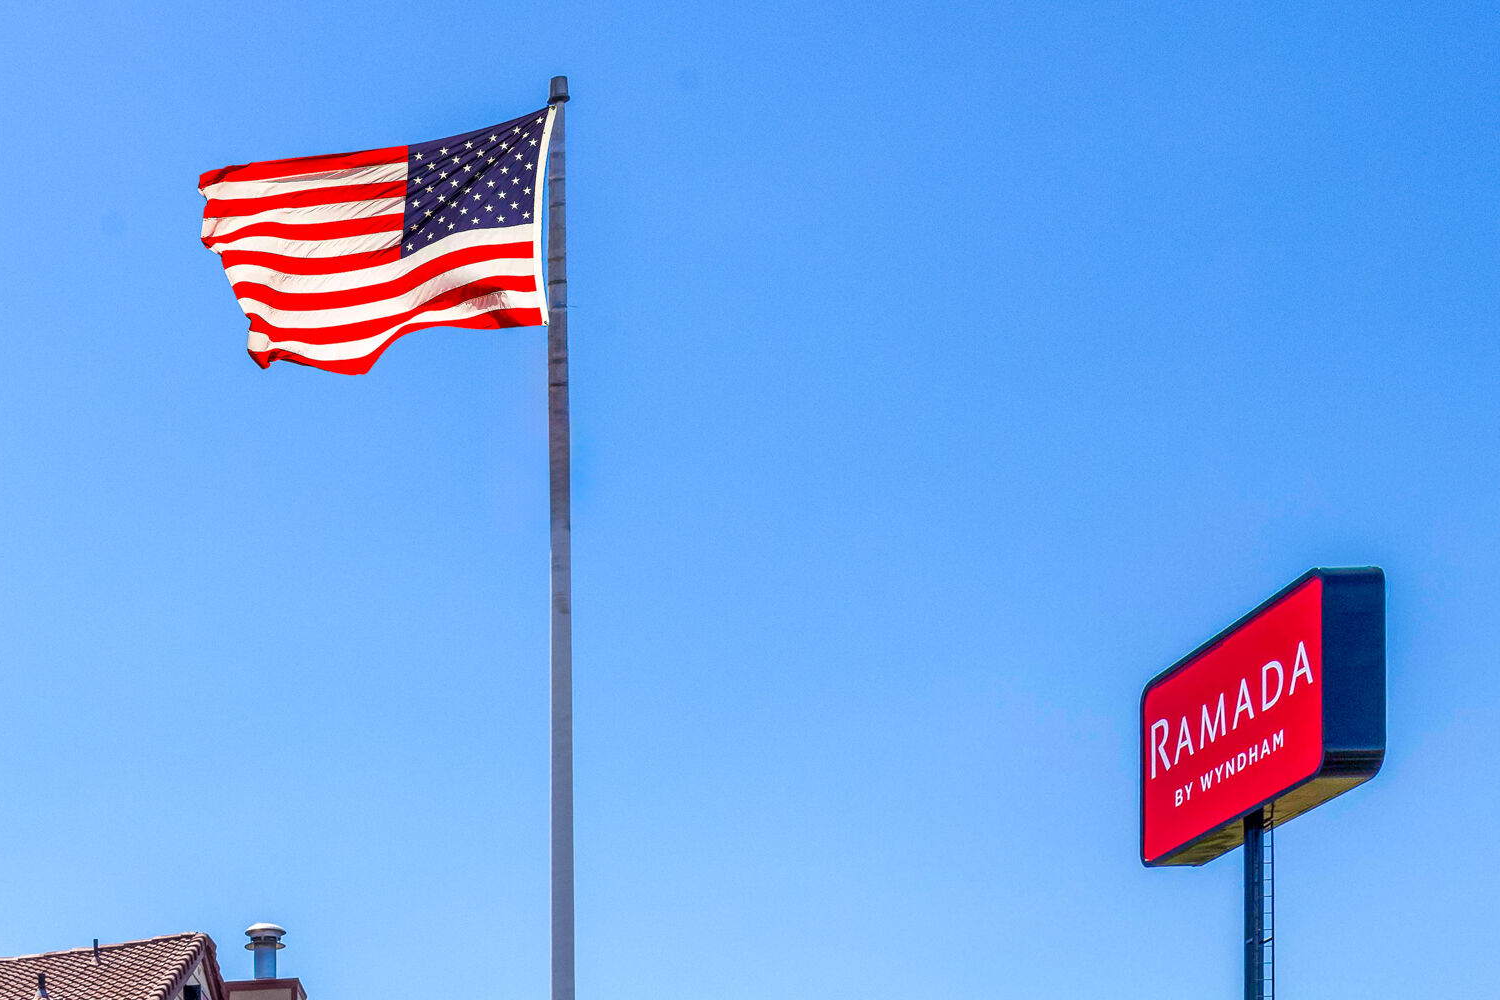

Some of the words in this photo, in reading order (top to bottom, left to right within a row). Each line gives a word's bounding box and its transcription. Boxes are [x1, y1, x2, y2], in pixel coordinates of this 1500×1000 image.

[1150, 640, 1314, 780] RAMADA
[1174, 781, 1194, 808] BY
[1199, 728, 1285, 793] WYNDHAM
